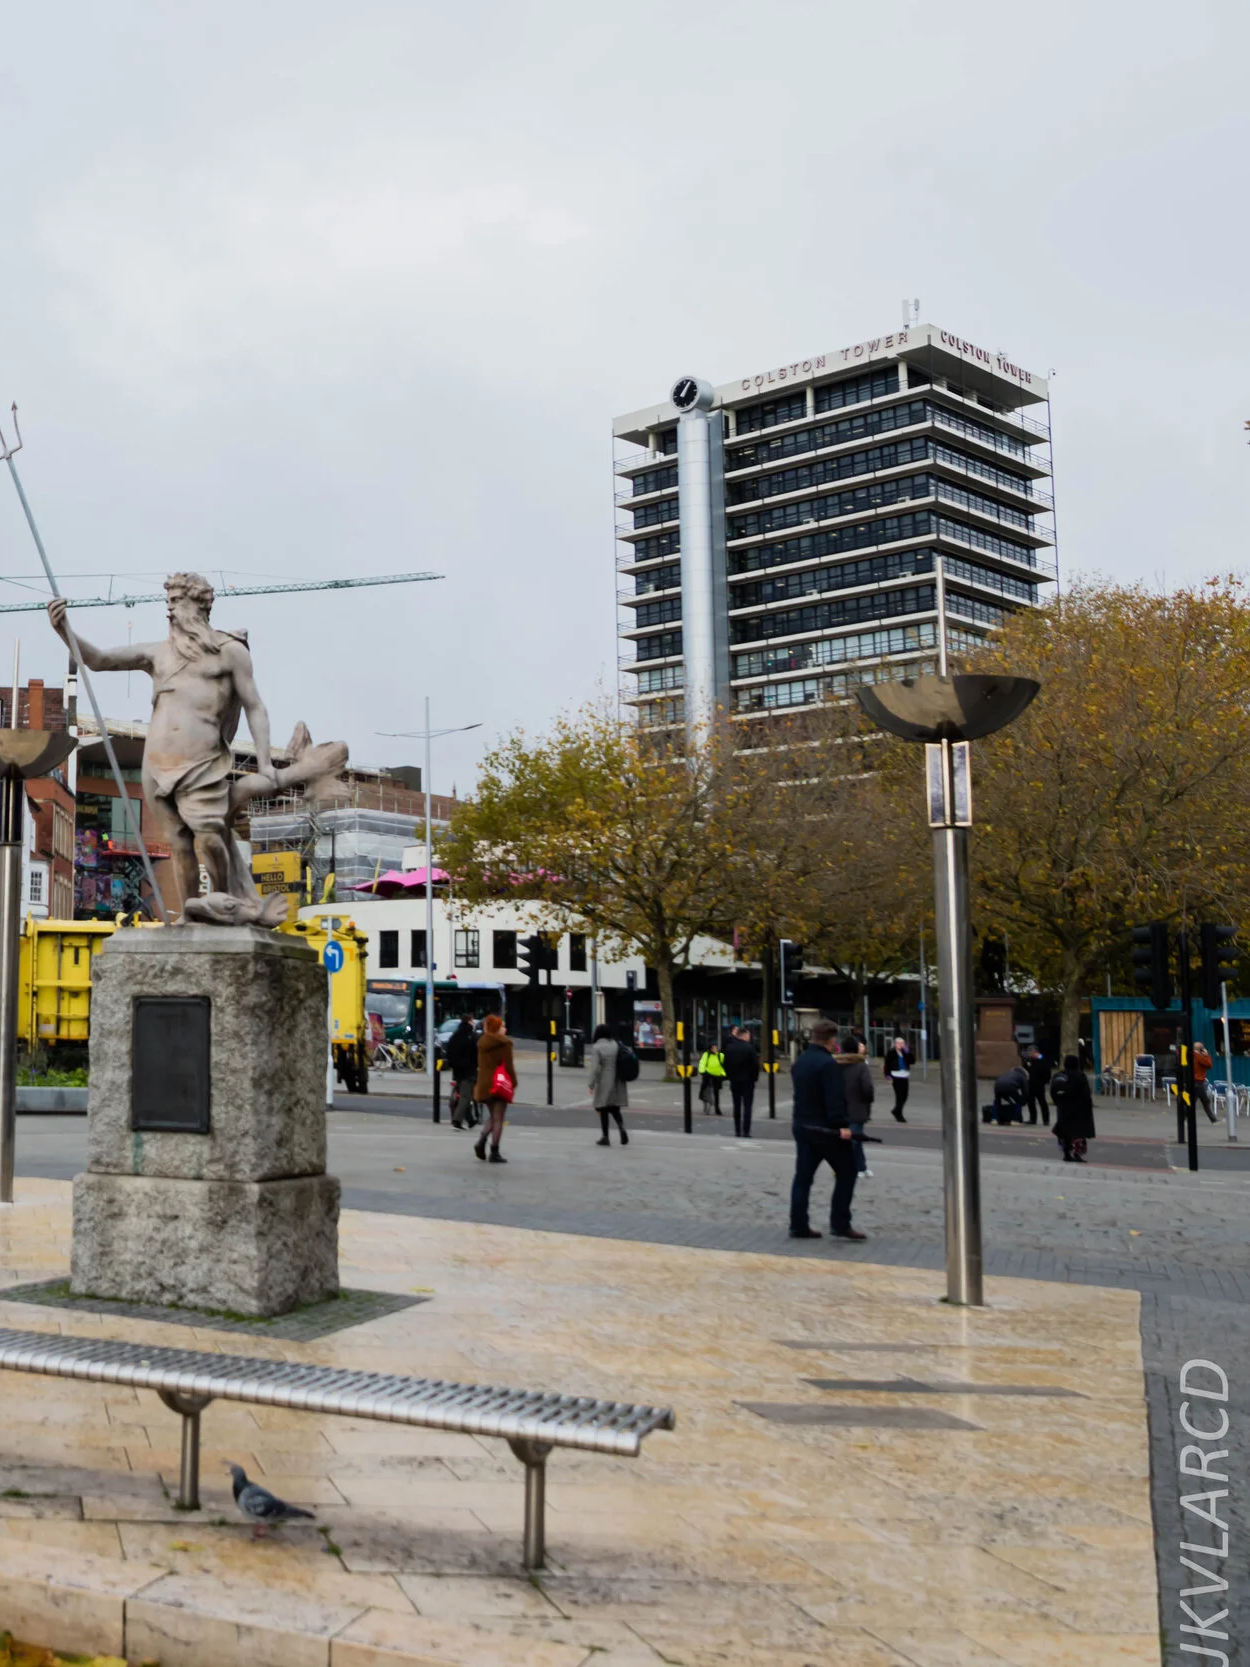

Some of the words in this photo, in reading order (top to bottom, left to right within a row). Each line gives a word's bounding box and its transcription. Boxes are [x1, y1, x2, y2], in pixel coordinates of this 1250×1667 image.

[741, 355, 826, 391] COLSTON
[841, 331, 908, 361] TOWER
[940, 330, 990, 364] COLSTON
[997, 357, 1032, 384] TOWER
[261, 873, 283, 882] HELLO
[262, 884, 290, 894] BRISTOL
